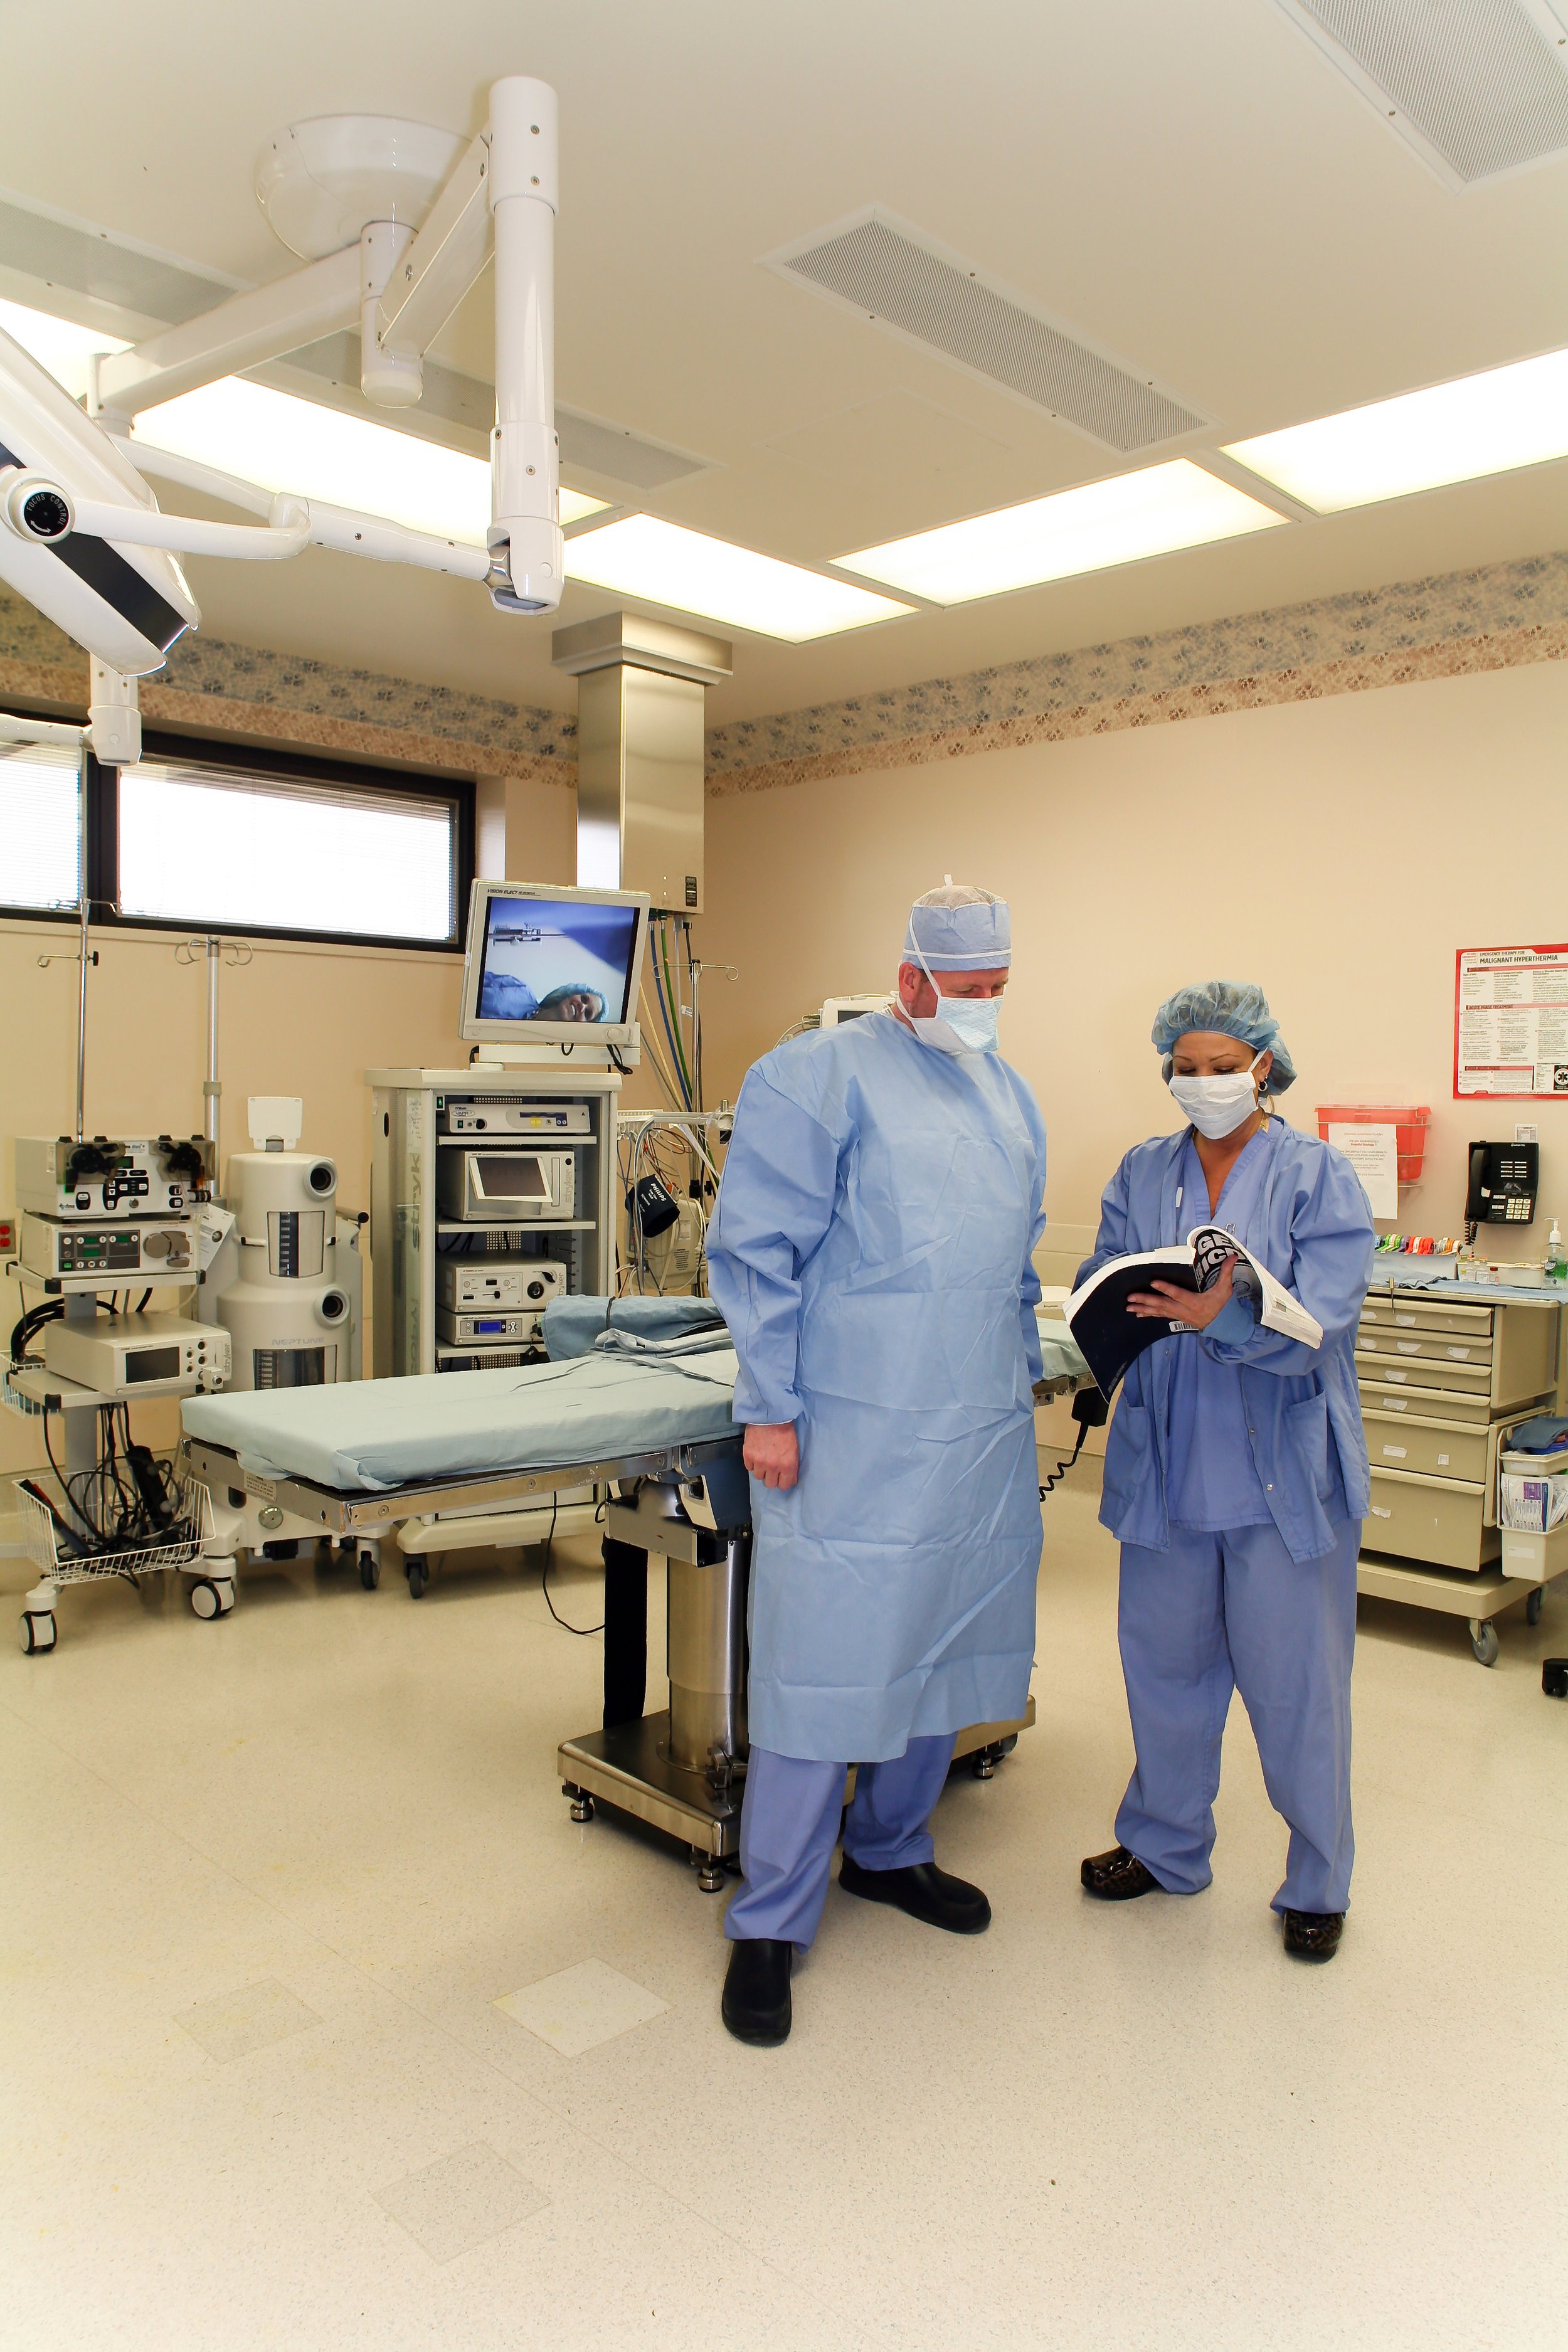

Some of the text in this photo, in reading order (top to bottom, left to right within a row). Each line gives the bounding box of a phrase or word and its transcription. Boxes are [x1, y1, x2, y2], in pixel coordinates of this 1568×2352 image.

[26, 493, 67, 526] FOCUS CONTROL
[1513, 955, 1559, 963] HYPERTHERMIA
[563, 1168, 572, 1203] stryker
[650, 1183, 667, 1202] PHILIPS
[411, 1153, 421, 1253] stryk
[1197, 1234, 1242, 1256] GE
[271, 1337, 325, 1345] NEPTUNE
